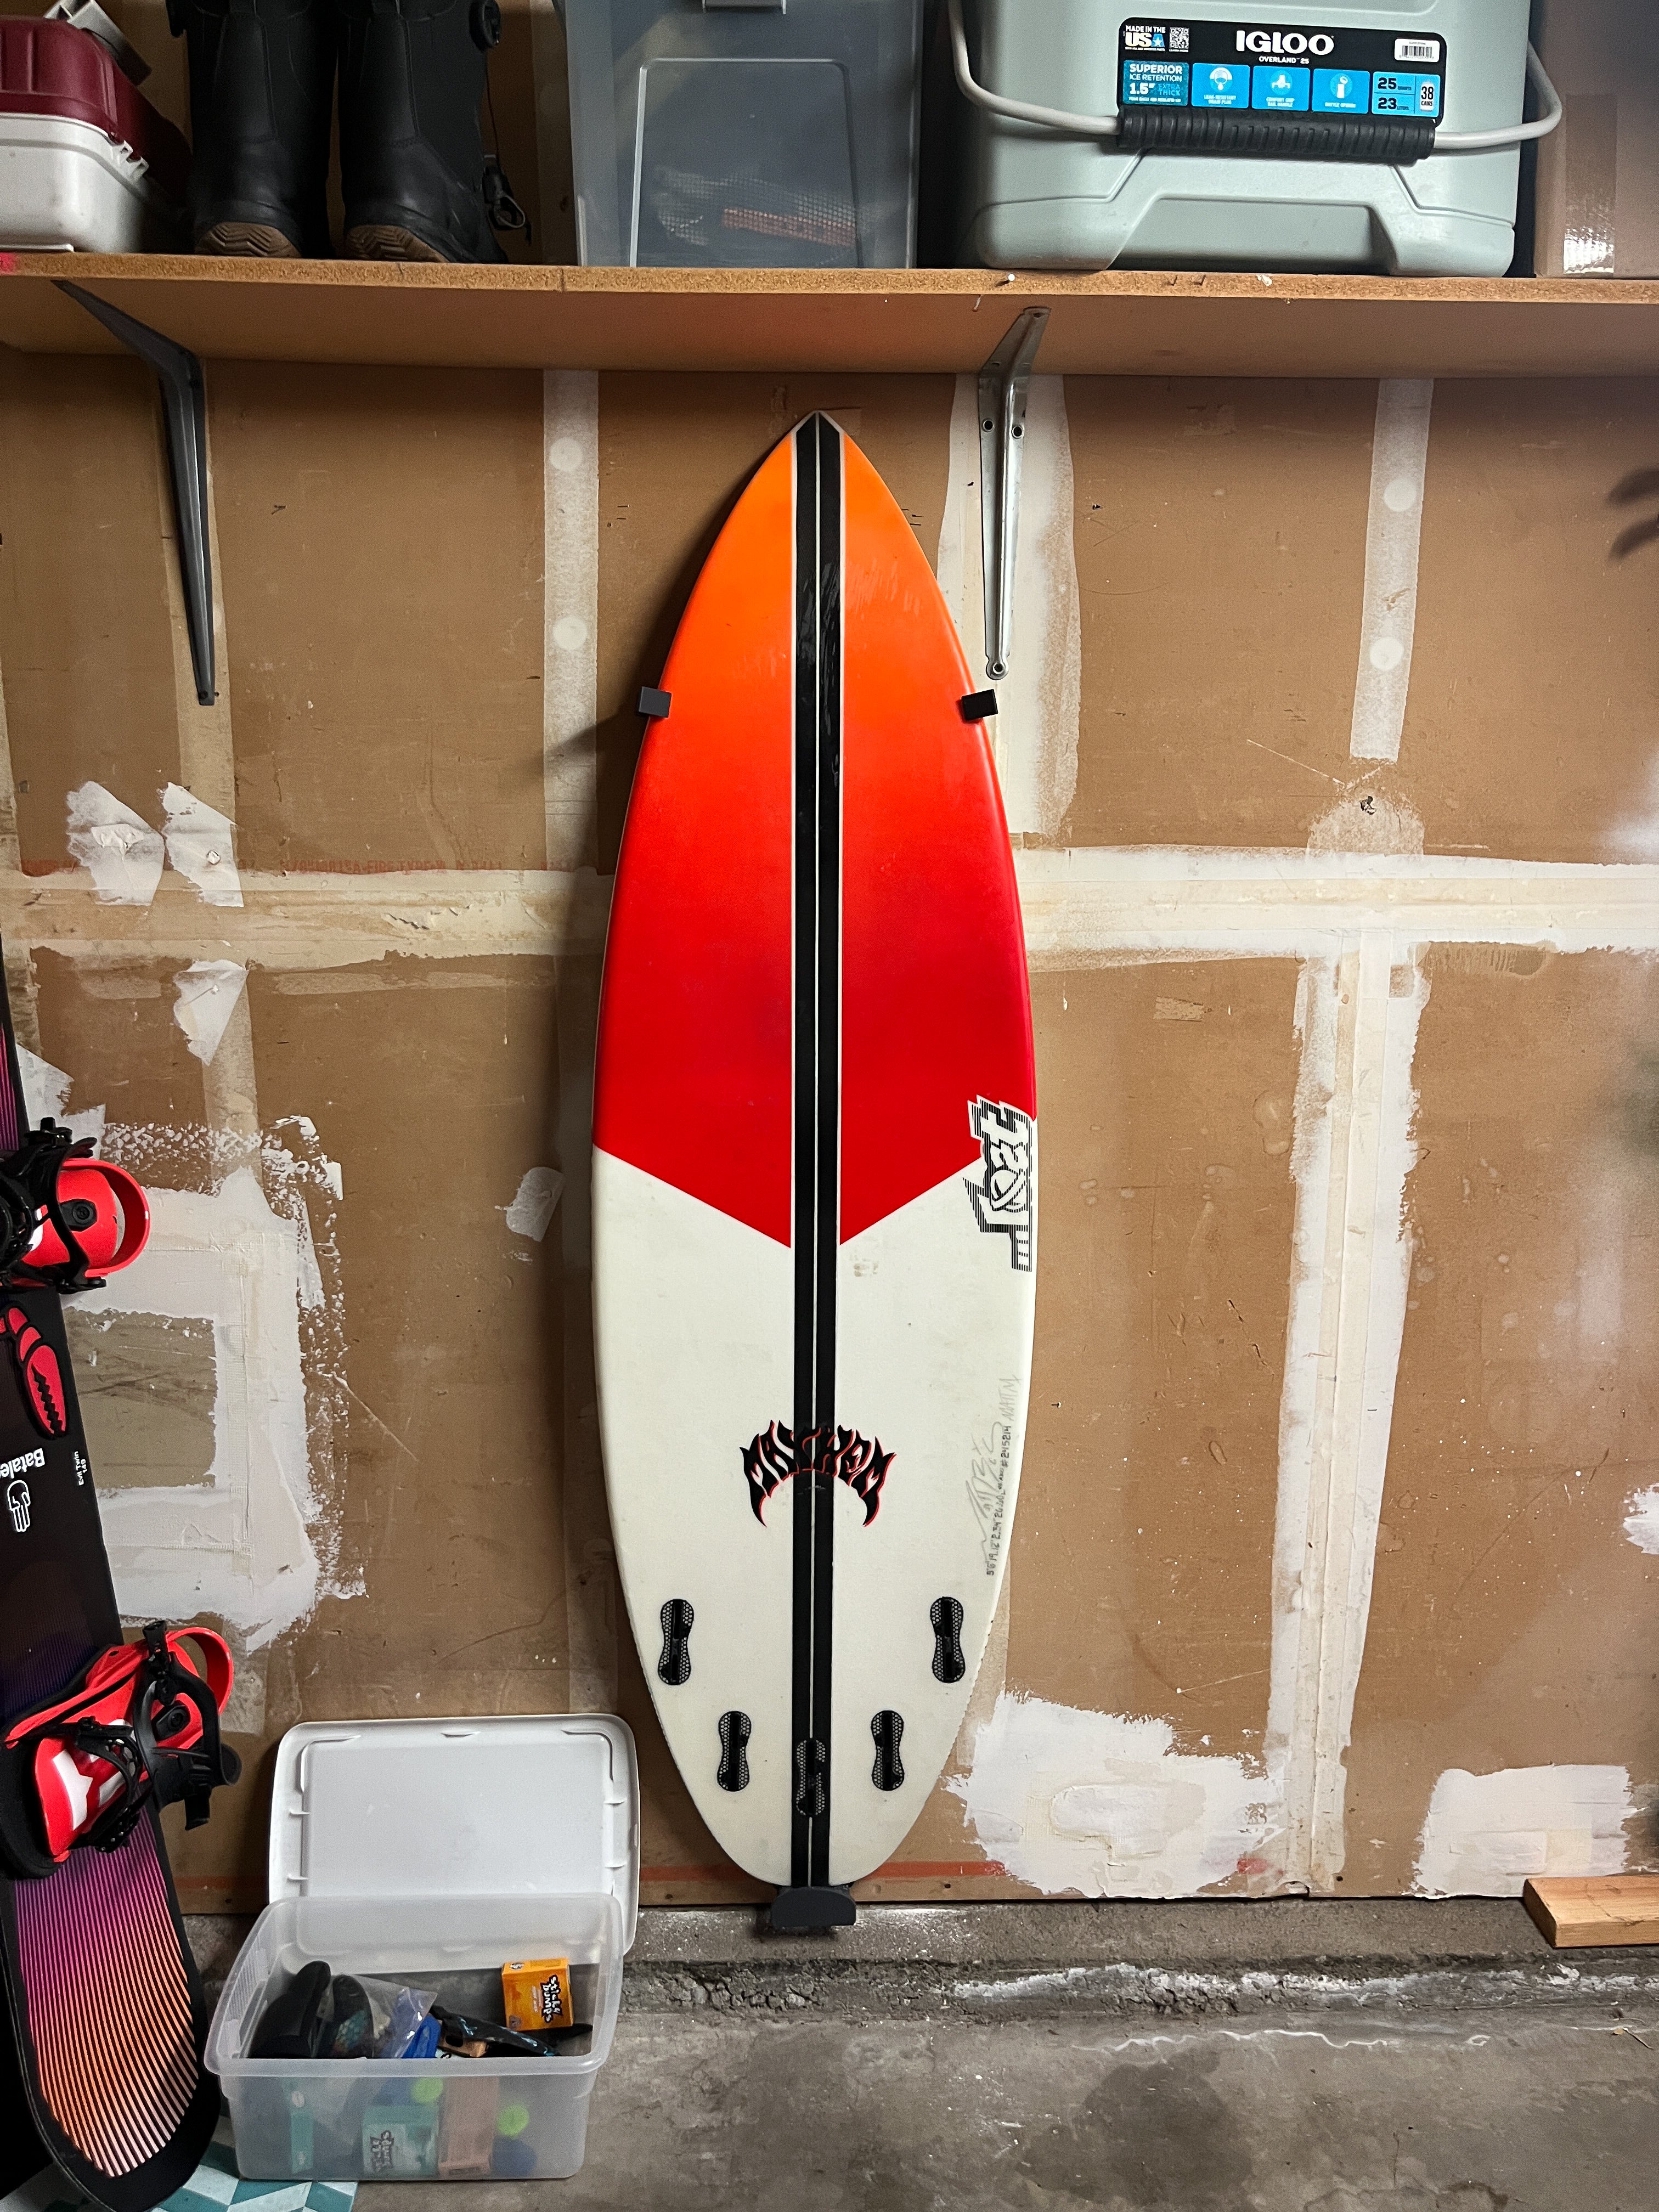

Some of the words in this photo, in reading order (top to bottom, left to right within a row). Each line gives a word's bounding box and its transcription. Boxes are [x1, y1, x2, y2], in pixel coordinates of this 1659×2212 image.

[1125, 32, 1165, 47] USA
[1236, 30, 1334, 55] IGLOO
[1130, 63, 1183, 75] SUPERIOR
[1142, 74, 1182, 82] RETENTION
[1377, 77, 1397, 89] 25
[1421, 86, 1434, 100] 38
[1377, 97, 1397, 110] 23
[0, 1448, 46, 1479] Batale
[550, 1976, 561, 2014] sticky
[542, 1983, 552, 2022] bumps
